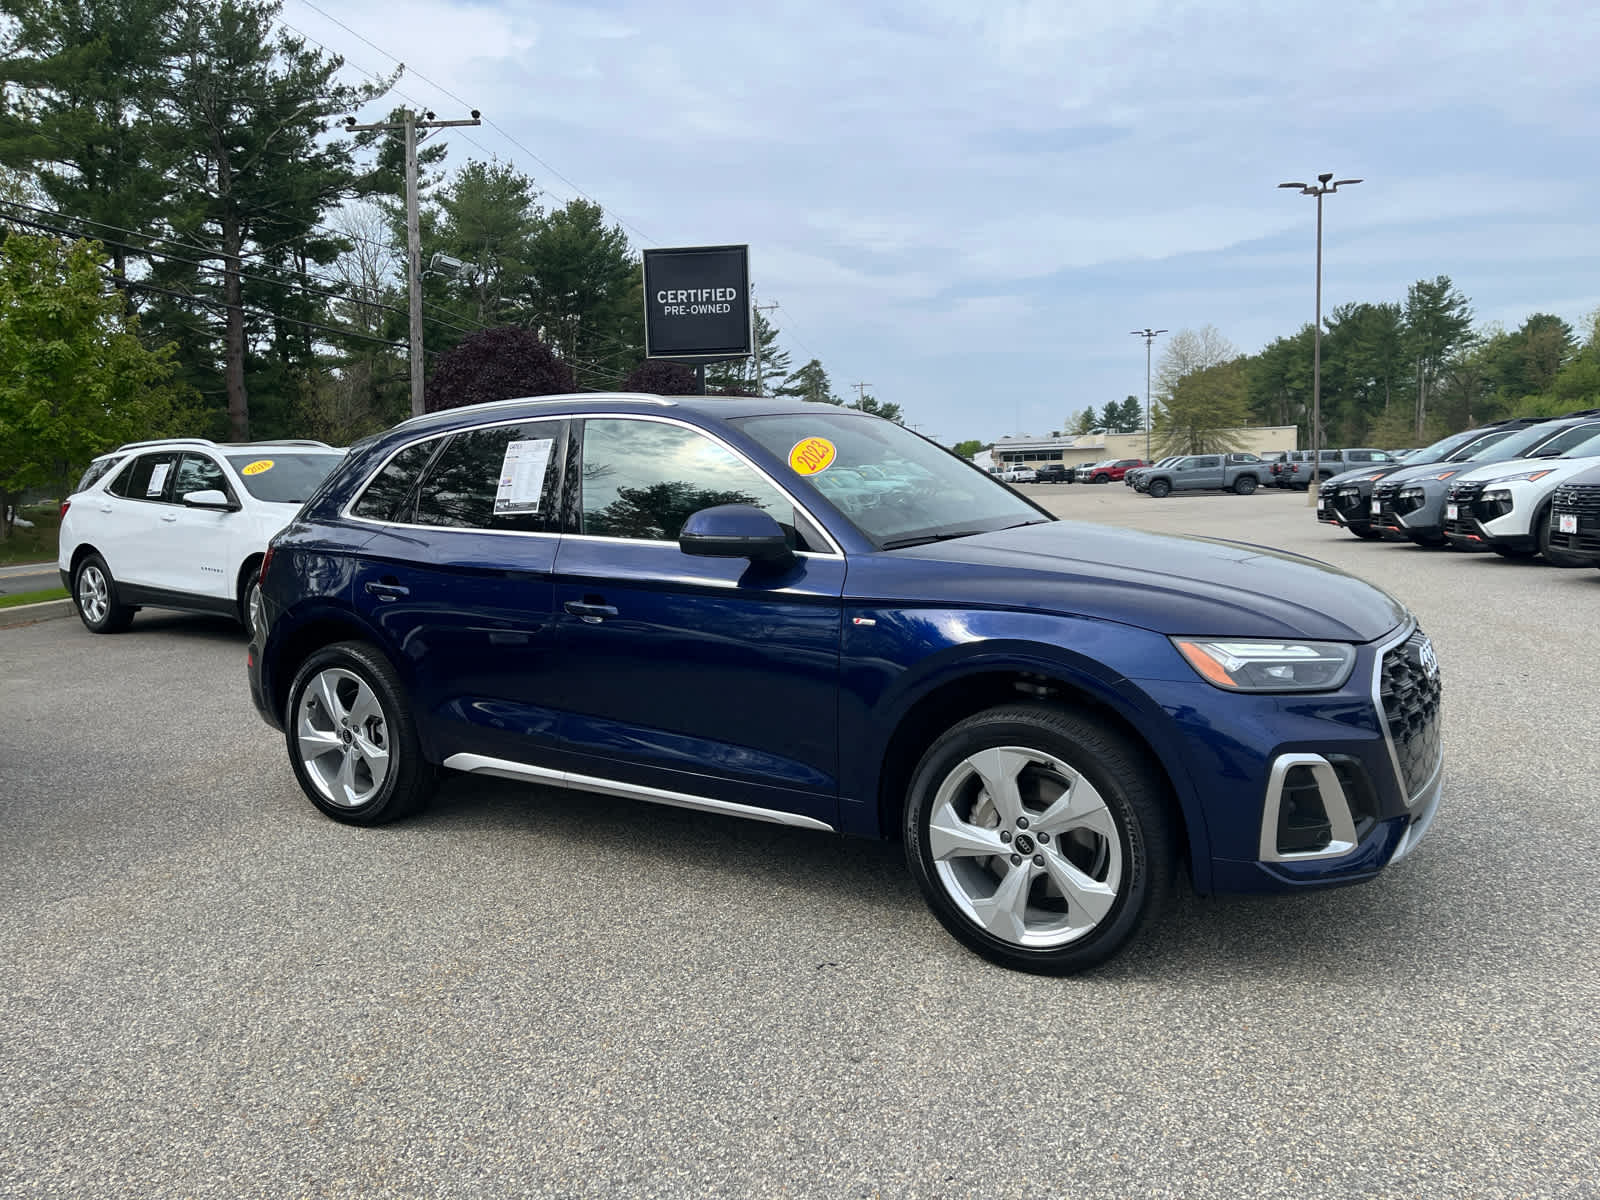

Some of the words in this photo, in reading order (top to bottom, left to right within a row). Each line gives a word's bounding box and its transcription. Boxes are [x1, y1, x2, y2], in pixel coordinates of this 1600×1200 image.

[657, 288, 737, 303] CERTIFIED
[664, 304, 730, 316] PRE-OWNED
[796, 440, 830, 471] 2023
